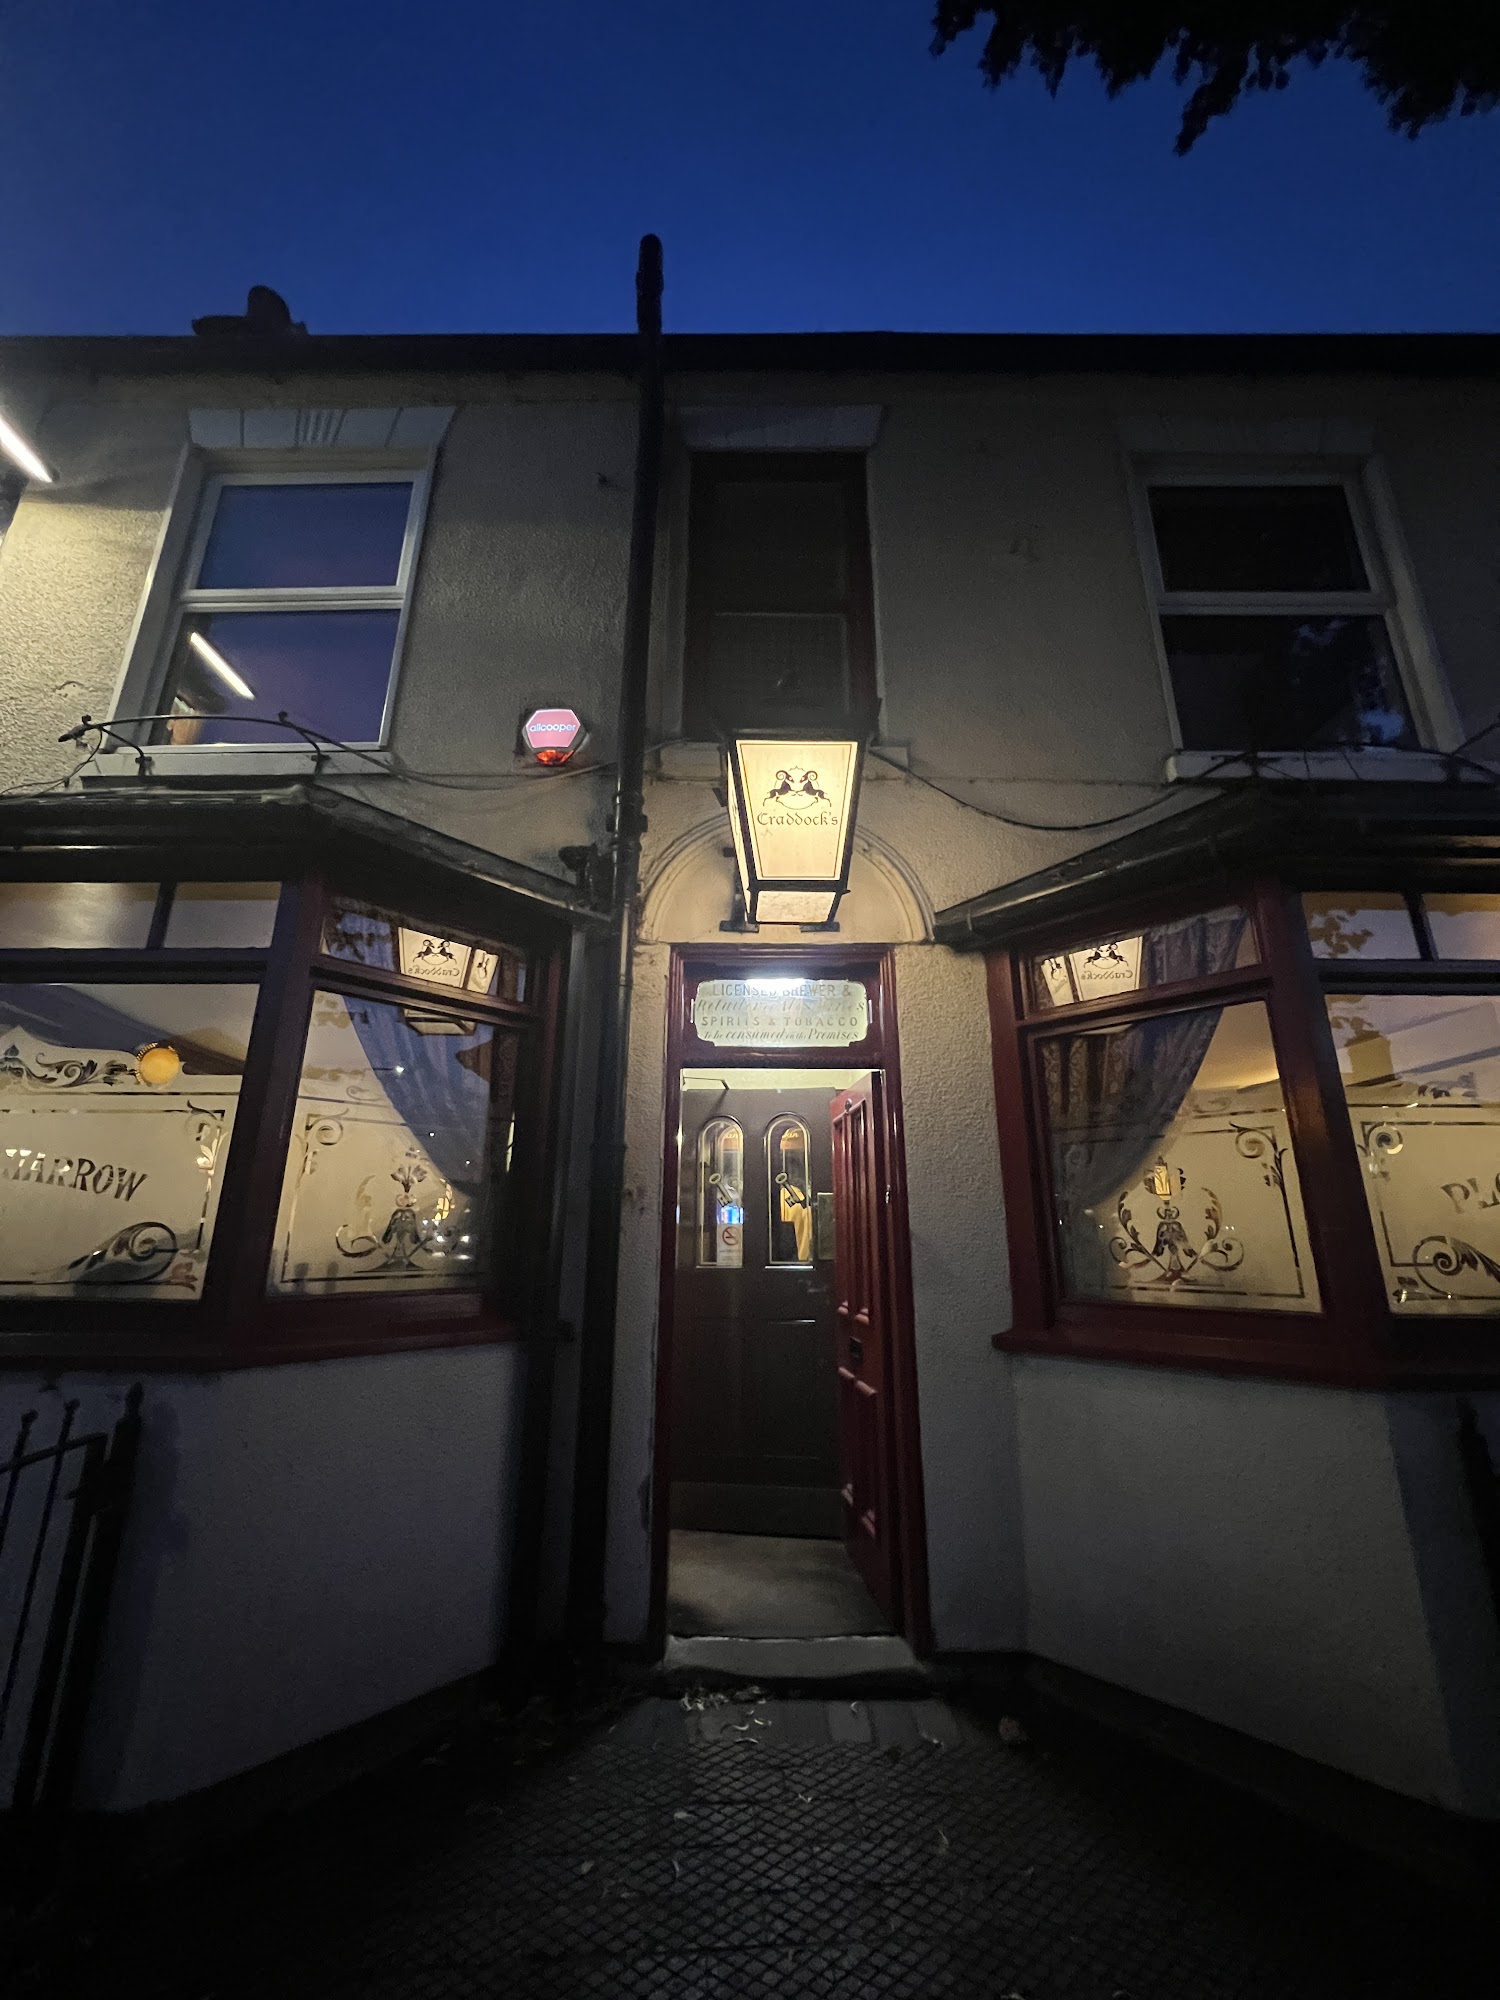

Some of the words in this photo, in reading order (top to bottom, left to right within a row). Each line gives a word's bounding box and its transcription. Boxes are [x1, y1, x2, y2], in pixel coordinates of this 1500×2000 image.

[529, 723, 576, 733] allcooper
[757, 811, 838, 826] Craddock's
[782, 984, 836, 997] BREWER
[842, 984, 852, 997] &
[701, 1016, 760, 1026] SPIRITS
[768, 1016, 776, 1026] &
[784, 1016, 858, 1026] TOBACCO
[725, 1028, 785, 1039] consumed
[808, 1028, 859, 1039] Premises
[1440, 1172, 1500, 1215] PL
